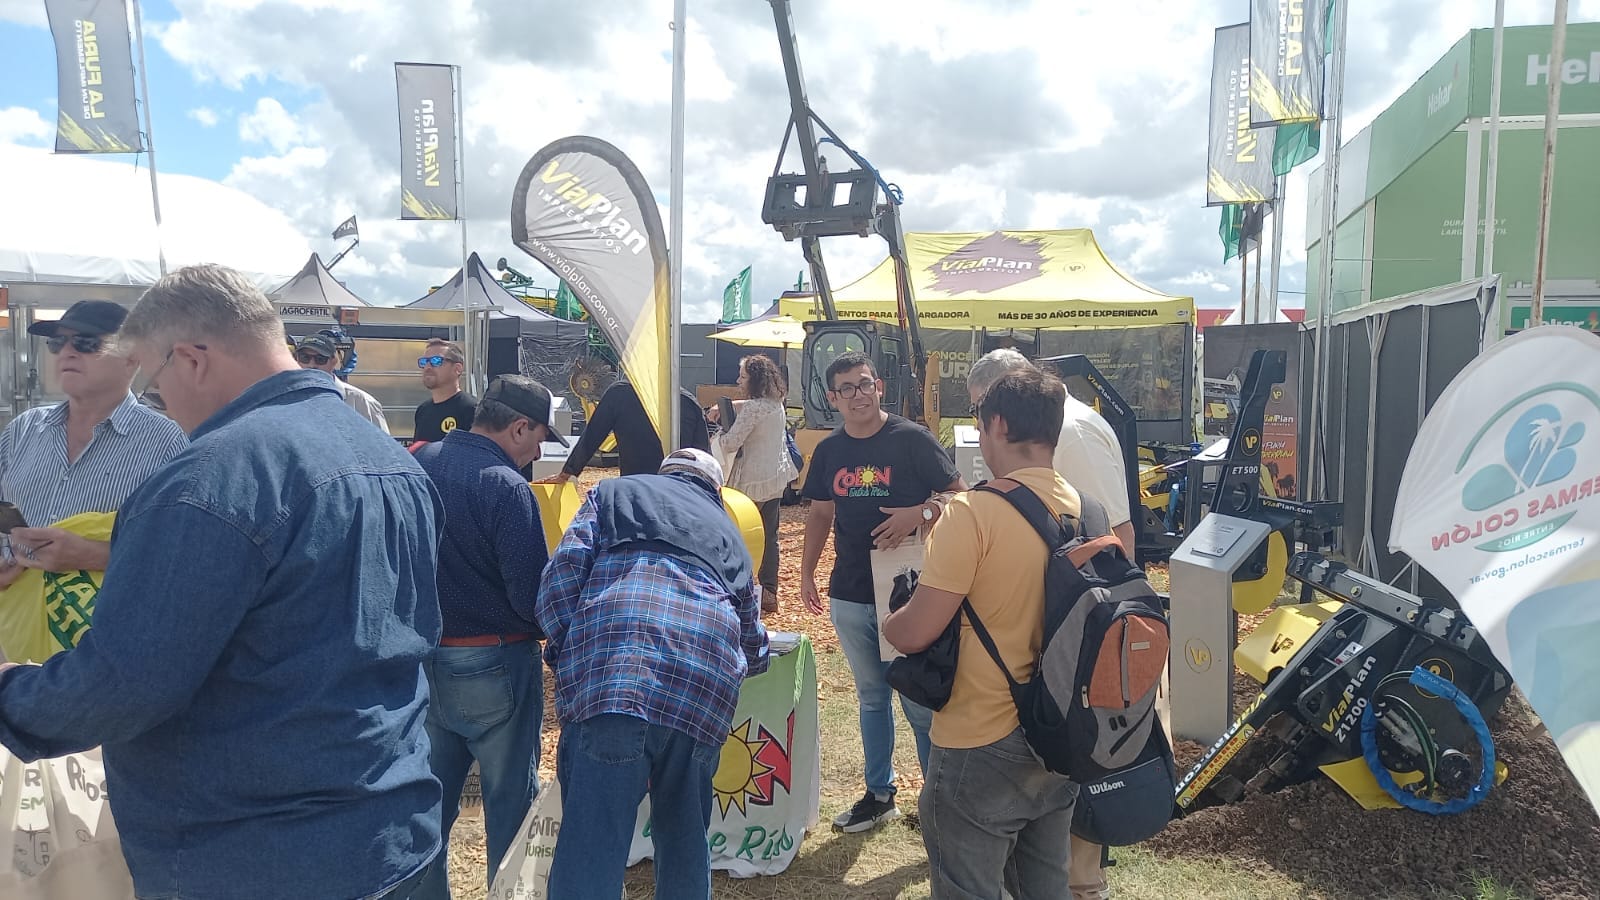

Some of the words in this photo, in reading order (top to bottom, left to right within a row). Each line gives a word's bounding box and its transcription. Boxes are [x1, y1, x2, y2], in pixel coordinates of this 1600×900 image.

[1526, 51, 1600, 86] Hel
[532, 238, 619, 331] www.vialplan.com.ar
[998, 312, 1019, 320] MÁS
[1020, 312, 1034, 320] DE
[1034, 312, 1047, 320] 30
[1049, 309, 1077, 319] AÑOS
[1080, 309, 1092, 318] DE
[1092, 308, 1159, 318] EXPERIENCIA
[1232, 466, 1244, 475] ET
[1244, 465, 1258, 475] 500
[1334, 697, 1368, 743] Z1200
[1088, 780, 1126, 795] Wilson
